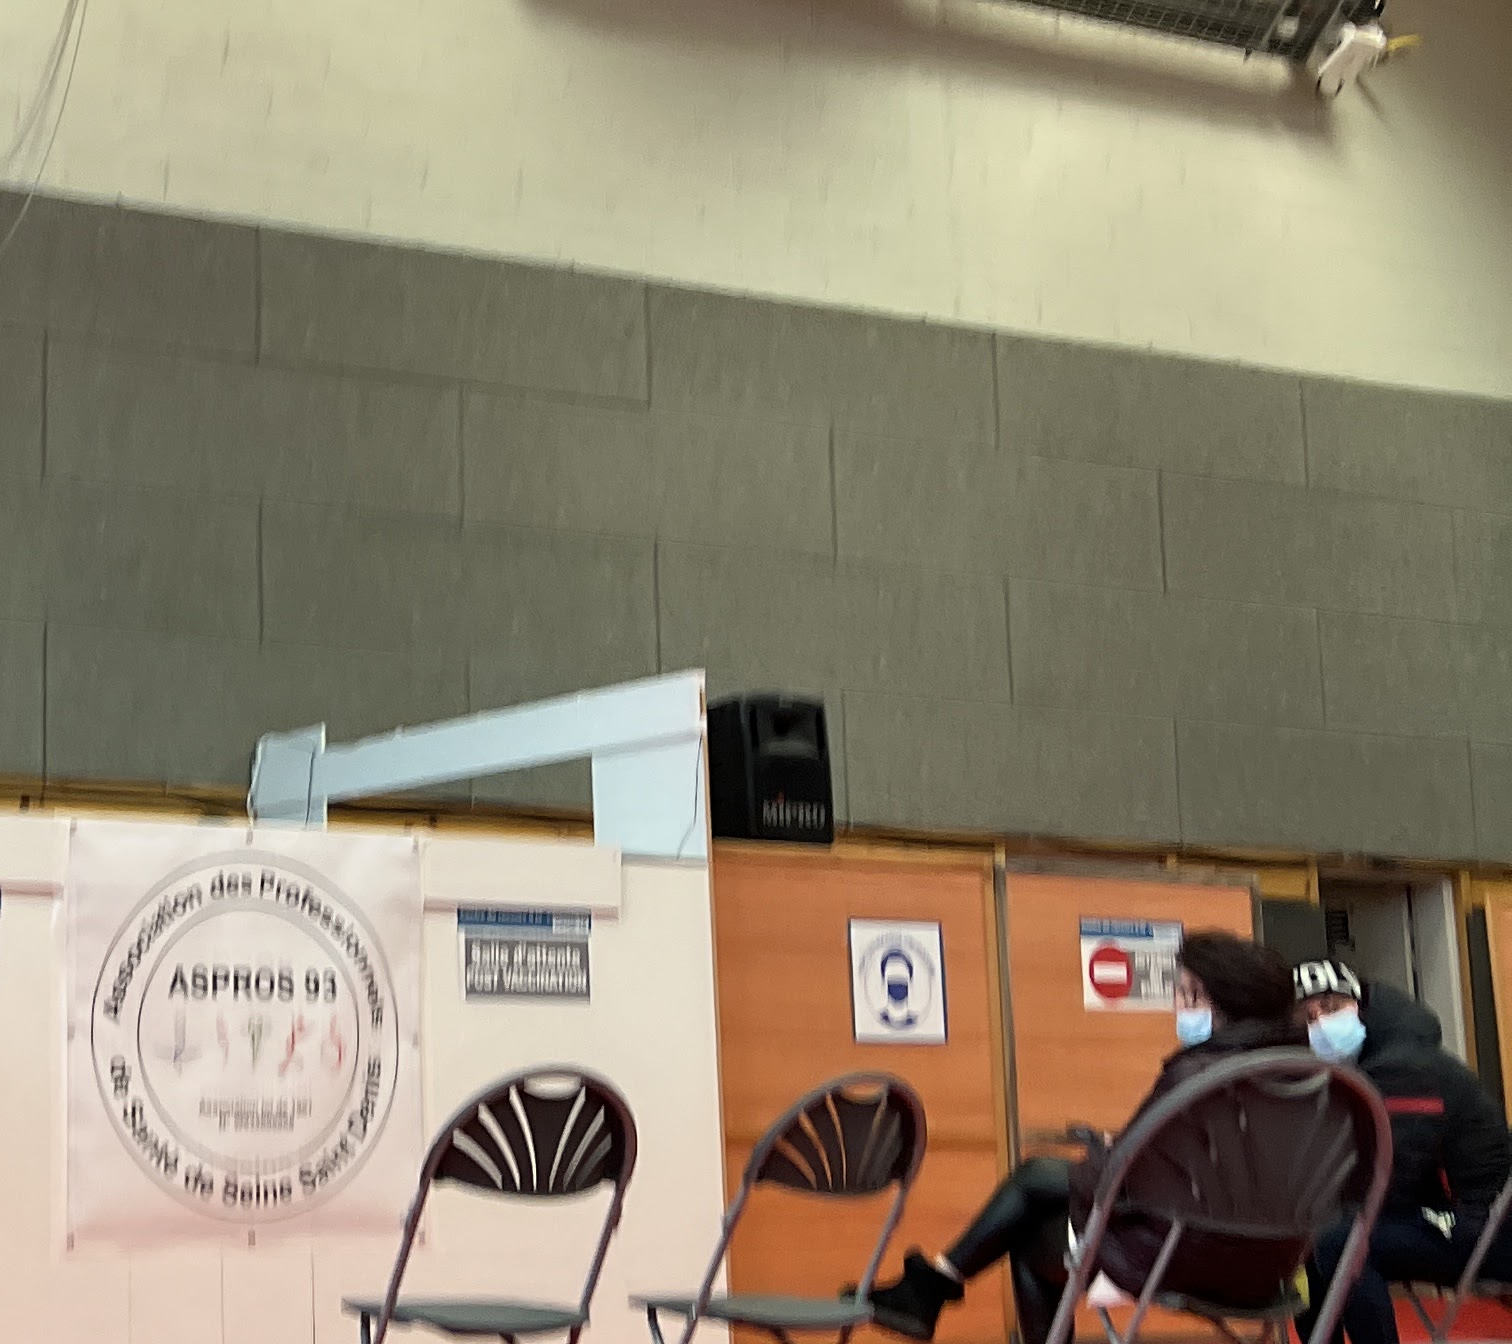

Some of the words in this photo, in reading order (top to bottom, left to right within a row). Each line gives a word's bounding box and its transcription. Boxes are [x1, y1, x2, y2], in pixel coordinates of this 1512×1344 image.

[103, 882, 202, 1025] Association
[210, 868, 252, 901] des
[168, 962, 295, 1001] ASPROS
[304, 965, 338, 1003] 93
[501, 965, 587, 994] VACCINATION
[110, 1054, 132, 1100] de
[184, 1161, 215, 1202] de
[221, 1171, 293, 1209] Seine
[298, 1129, 356, 1196] Saint
[347, 1055, 382, 1144] Denis
